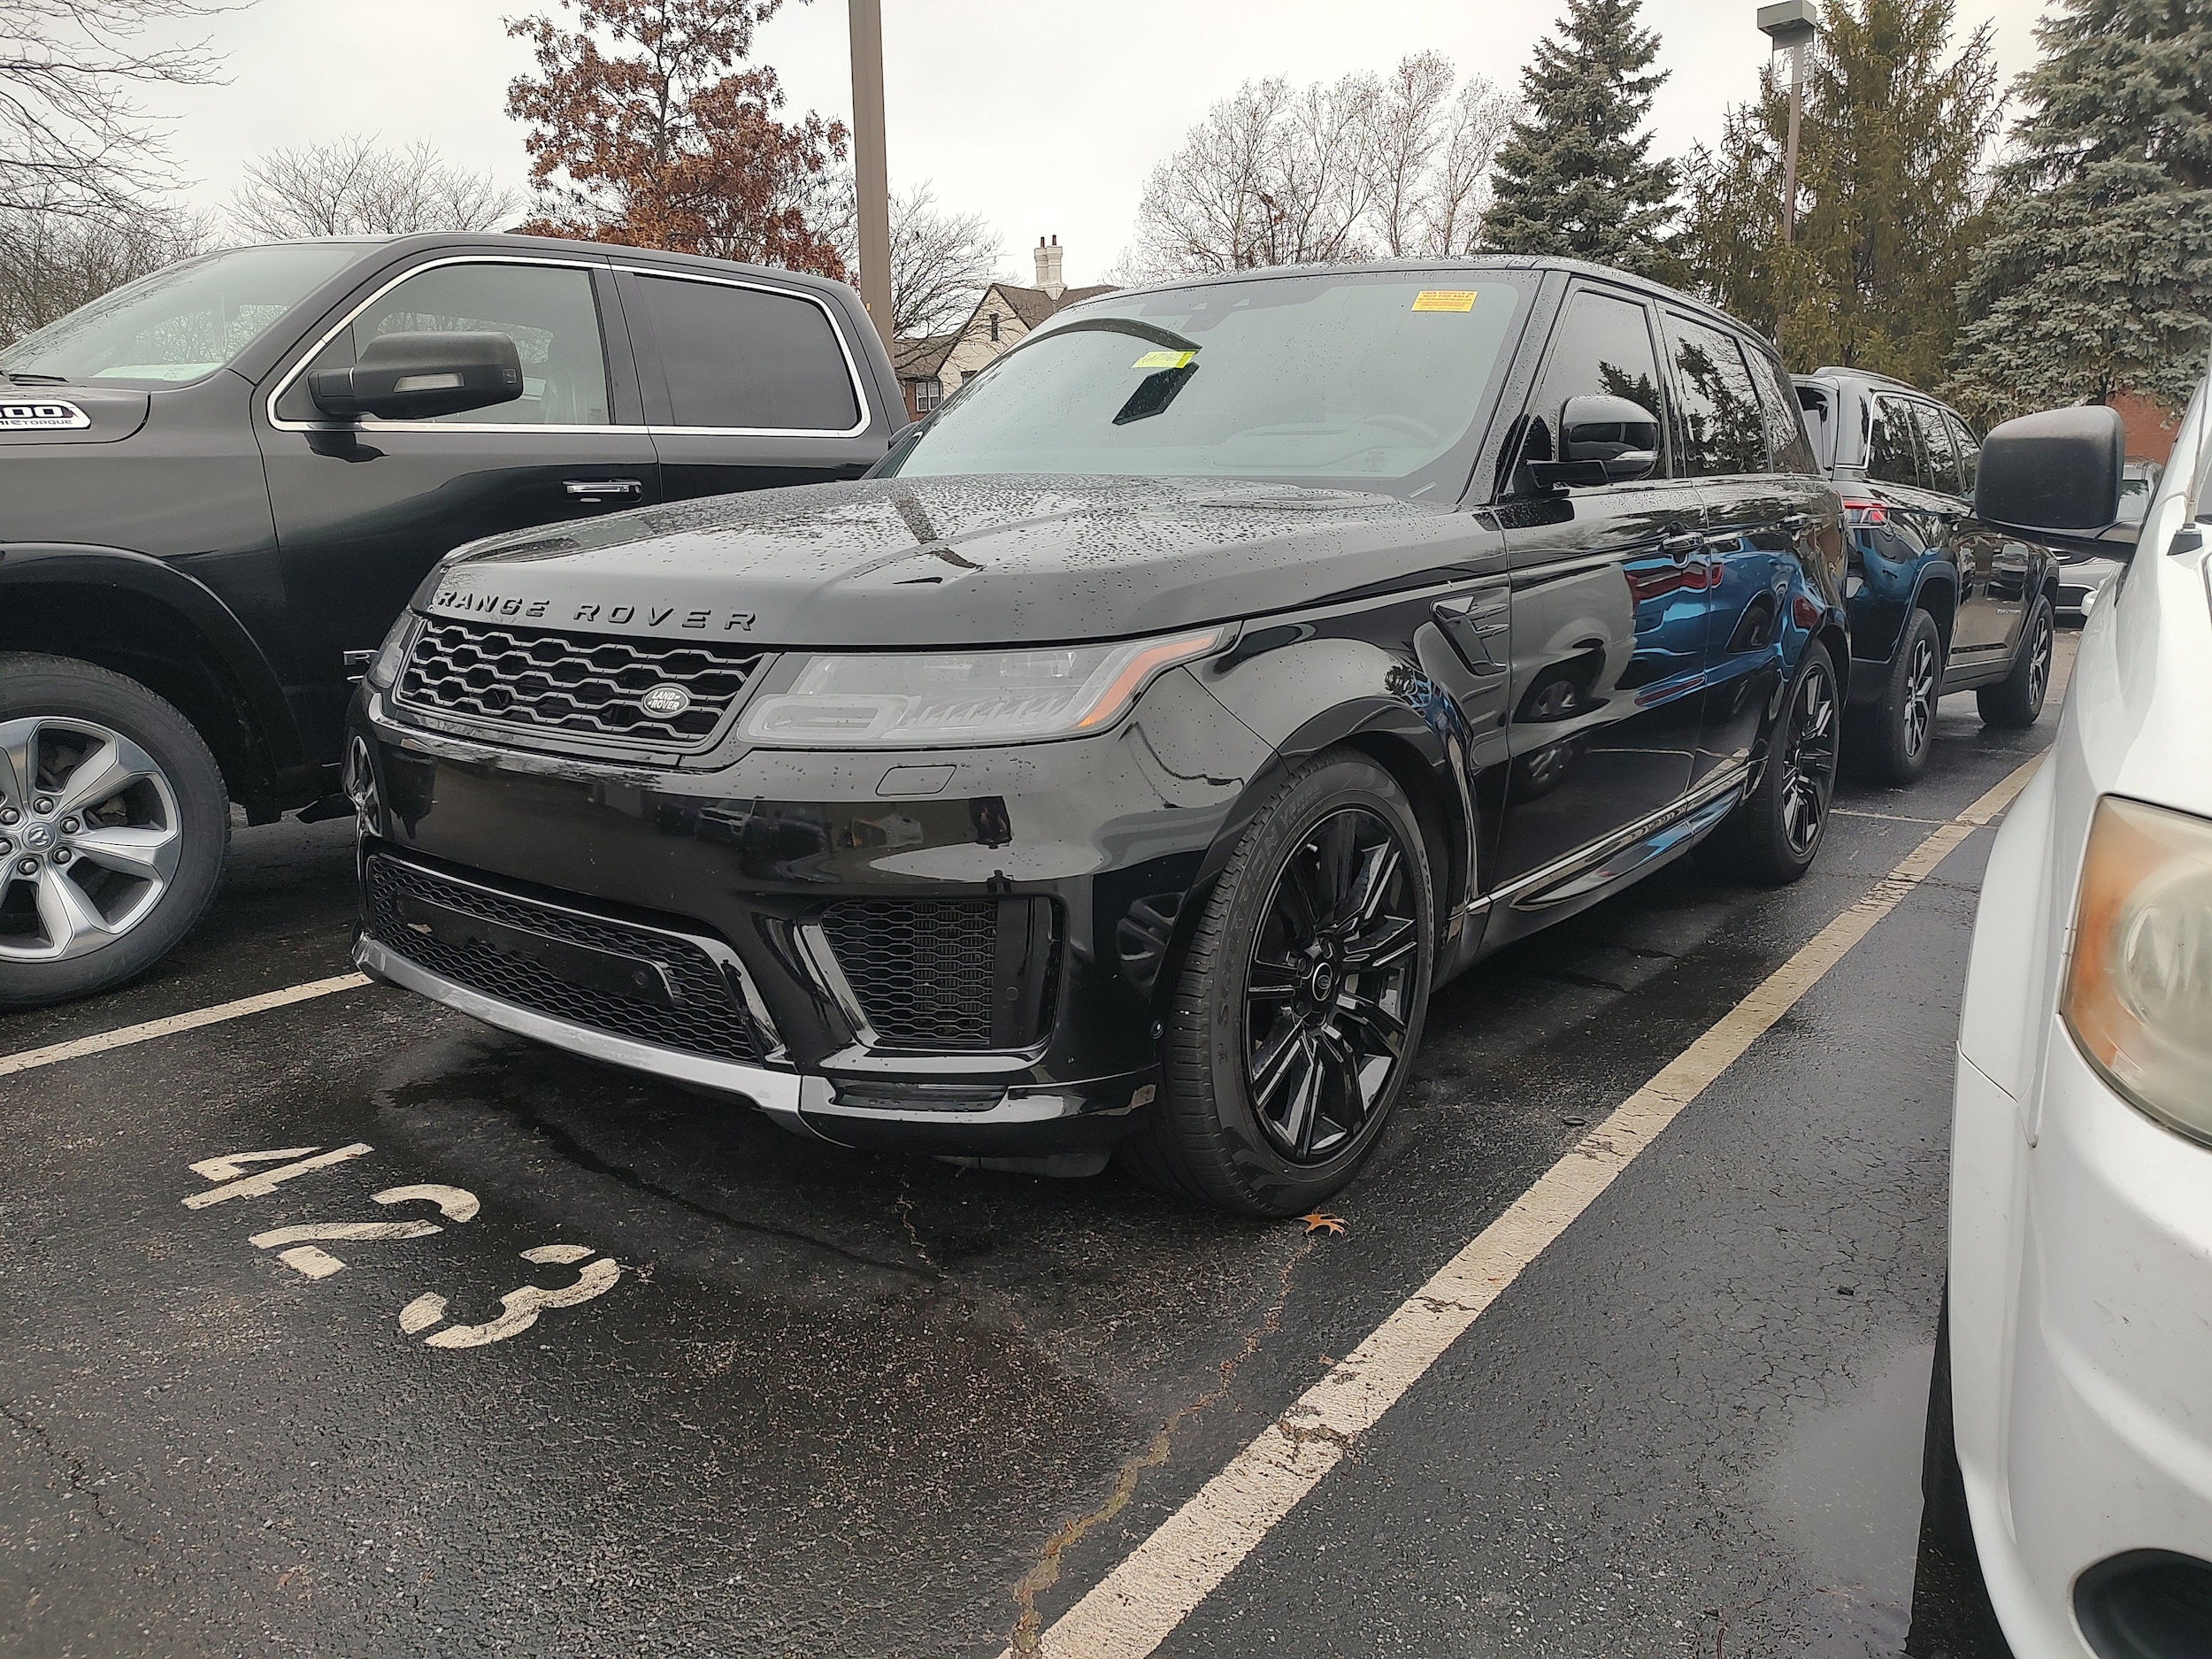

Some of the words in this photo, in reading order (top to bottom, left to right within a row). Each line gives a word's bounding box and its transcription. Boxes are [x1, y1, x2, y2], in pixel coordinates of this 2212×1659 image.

[0, 405, 64, 418] 00
[436, 590, 551, 618] RANGE
[572, 603, 757, 632] ROVER
[651, 690, 676, 701] LAND
[650, 699, 680, 710] ROVER
[180, 1141, 621, 1349] 423
